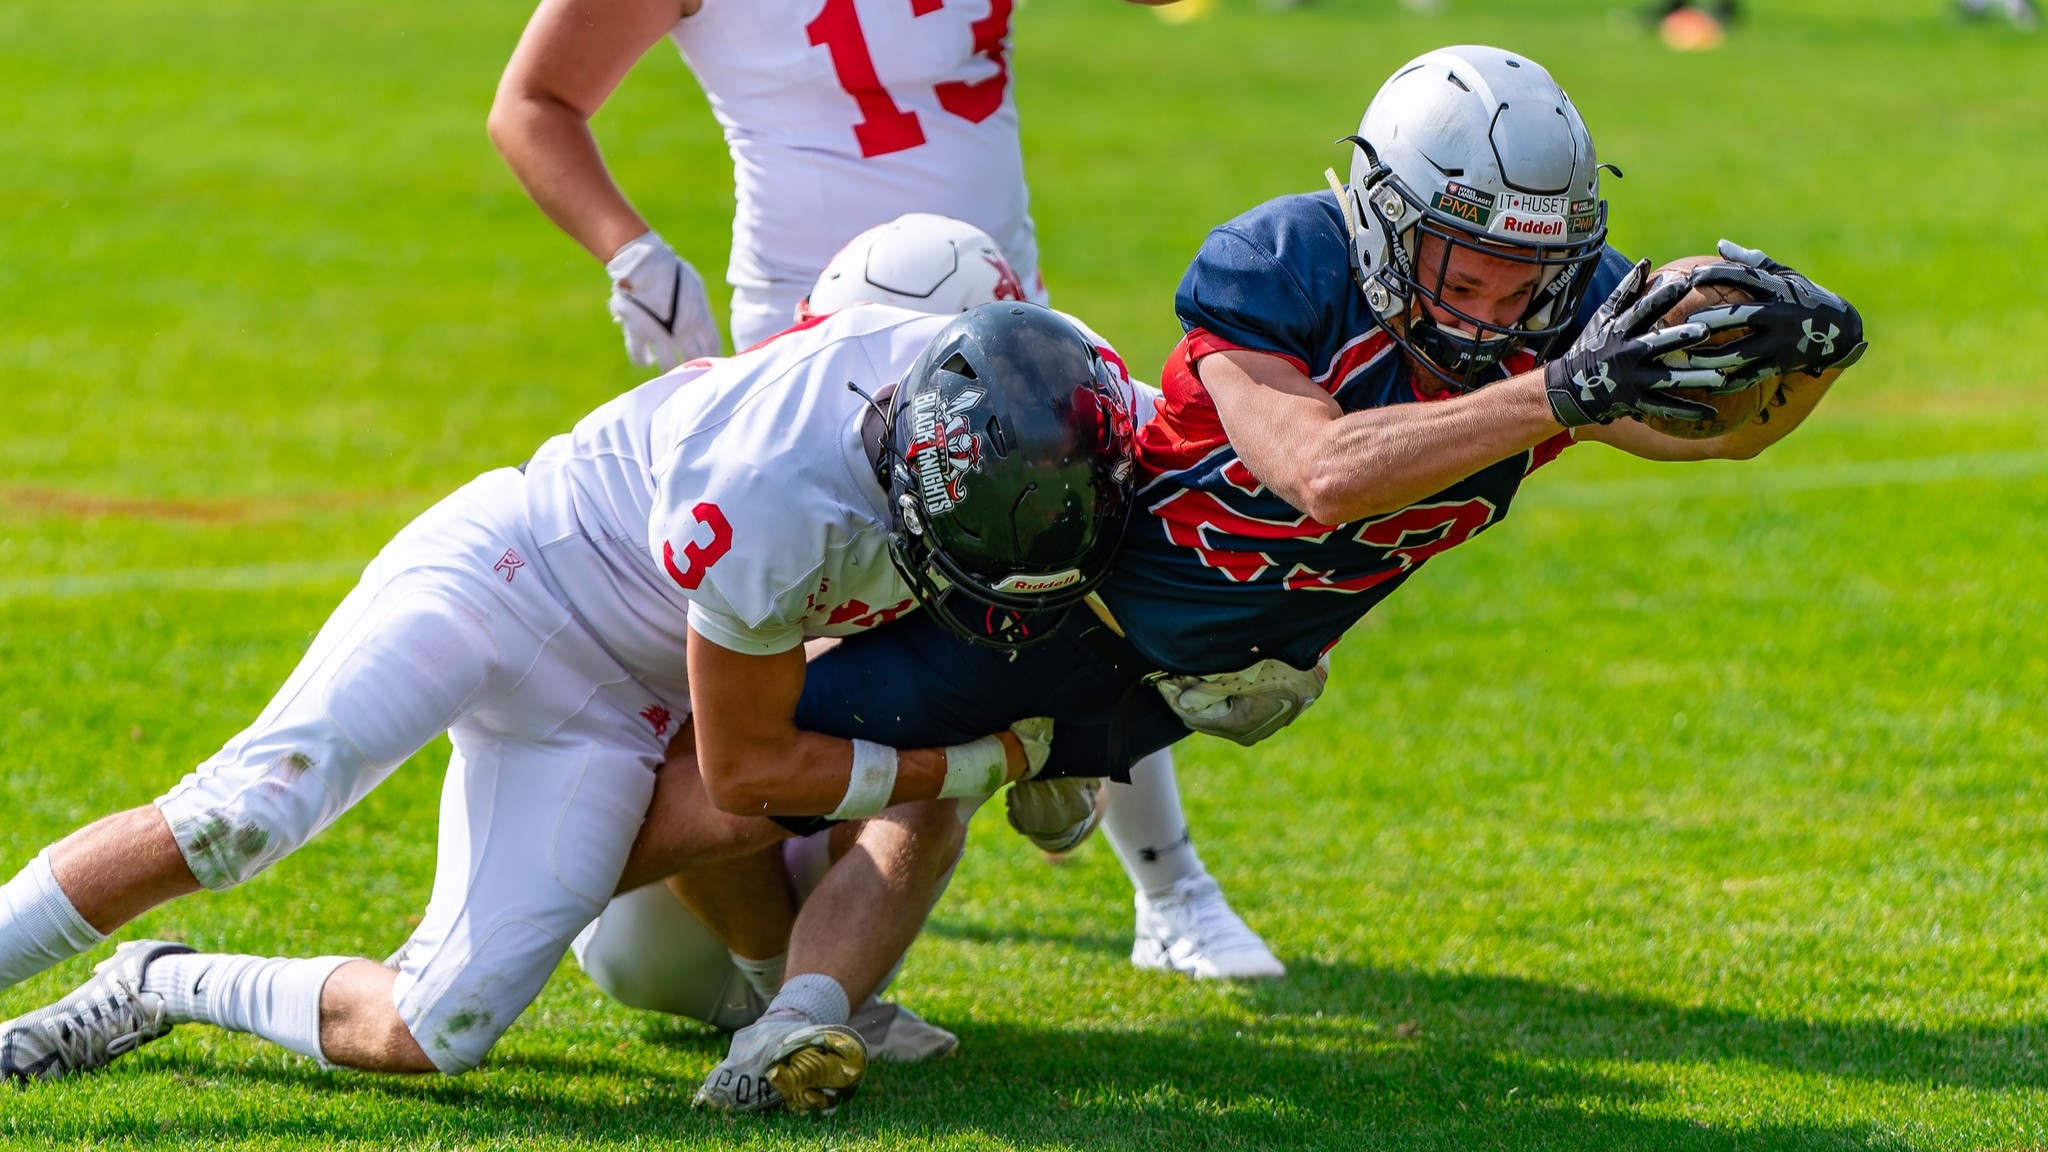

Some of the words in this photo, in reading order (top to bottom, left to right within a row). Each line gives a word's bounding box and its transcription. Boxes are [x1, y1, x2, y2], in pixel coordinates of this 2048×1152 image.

[804, 0, 1013, 158] 13
[1438, 195, 1478, 222] PMA
[1503, 215, 1563, 236] Riddell
[914, 392, 937, 445] BLACK
[918, 445, 953, 513] KNIGHTS
[663, 501, 734, 591] 3
[1013, 574, 1075, 590] Riddell
